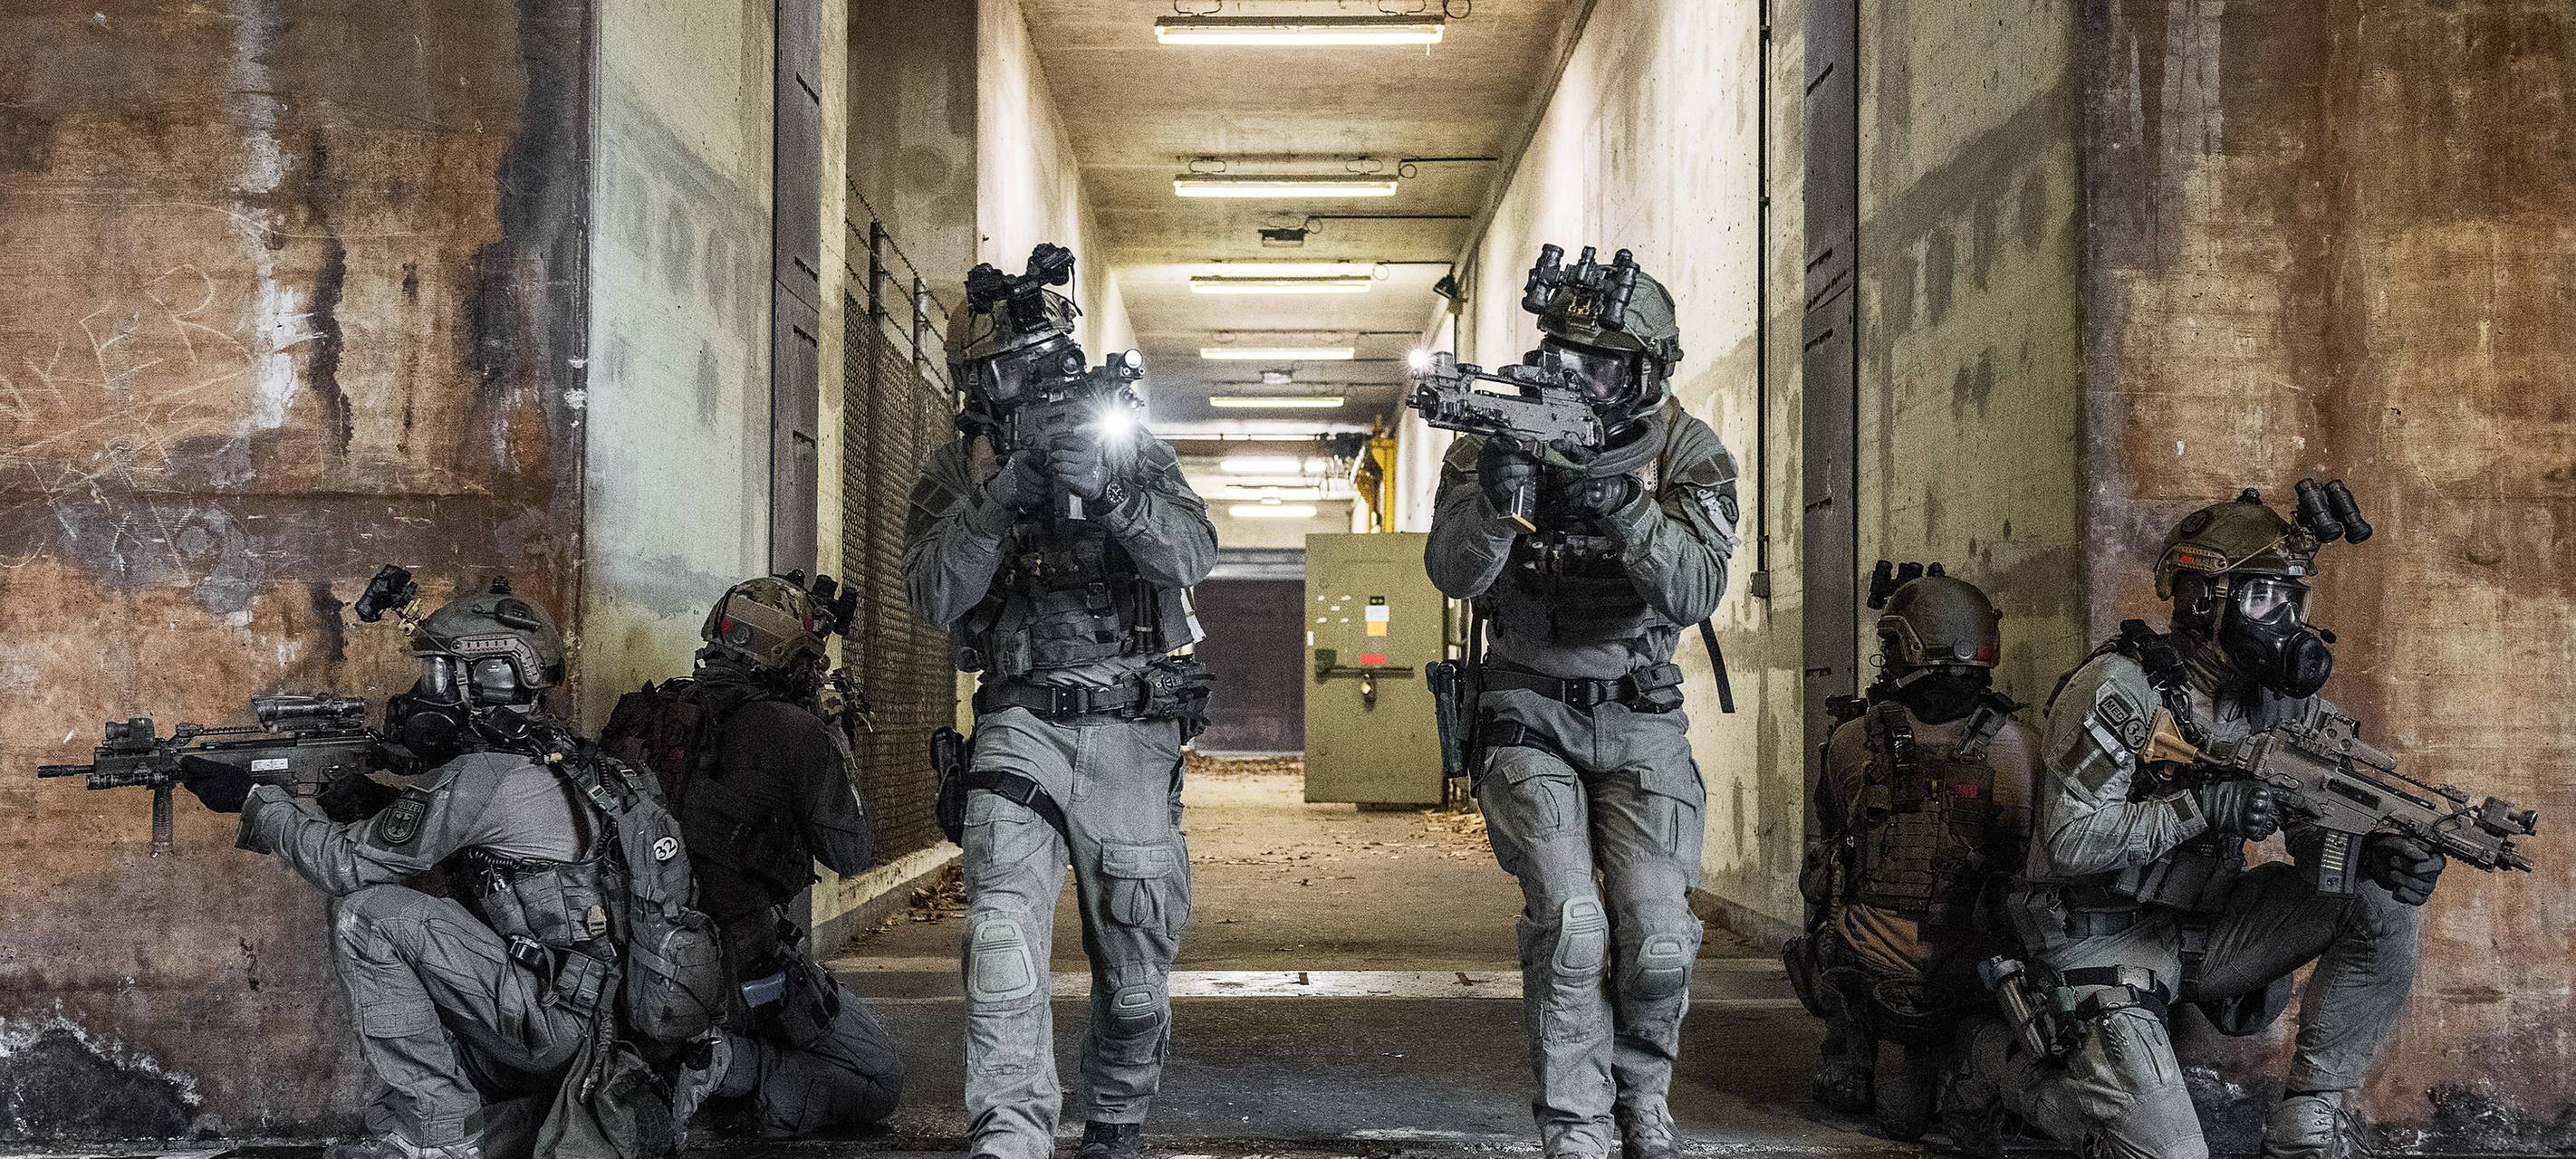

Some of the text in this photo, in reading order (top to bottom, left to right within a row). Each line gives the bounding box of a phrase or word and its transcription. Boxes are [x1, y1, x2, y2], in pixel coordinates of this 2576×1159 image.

[2104, 699, 2126, 721] MED
[2126, 723, 2145, 745] 34
[395, 800, 422, 813] OLIZEI
[655, 838, 678, 859] 32
